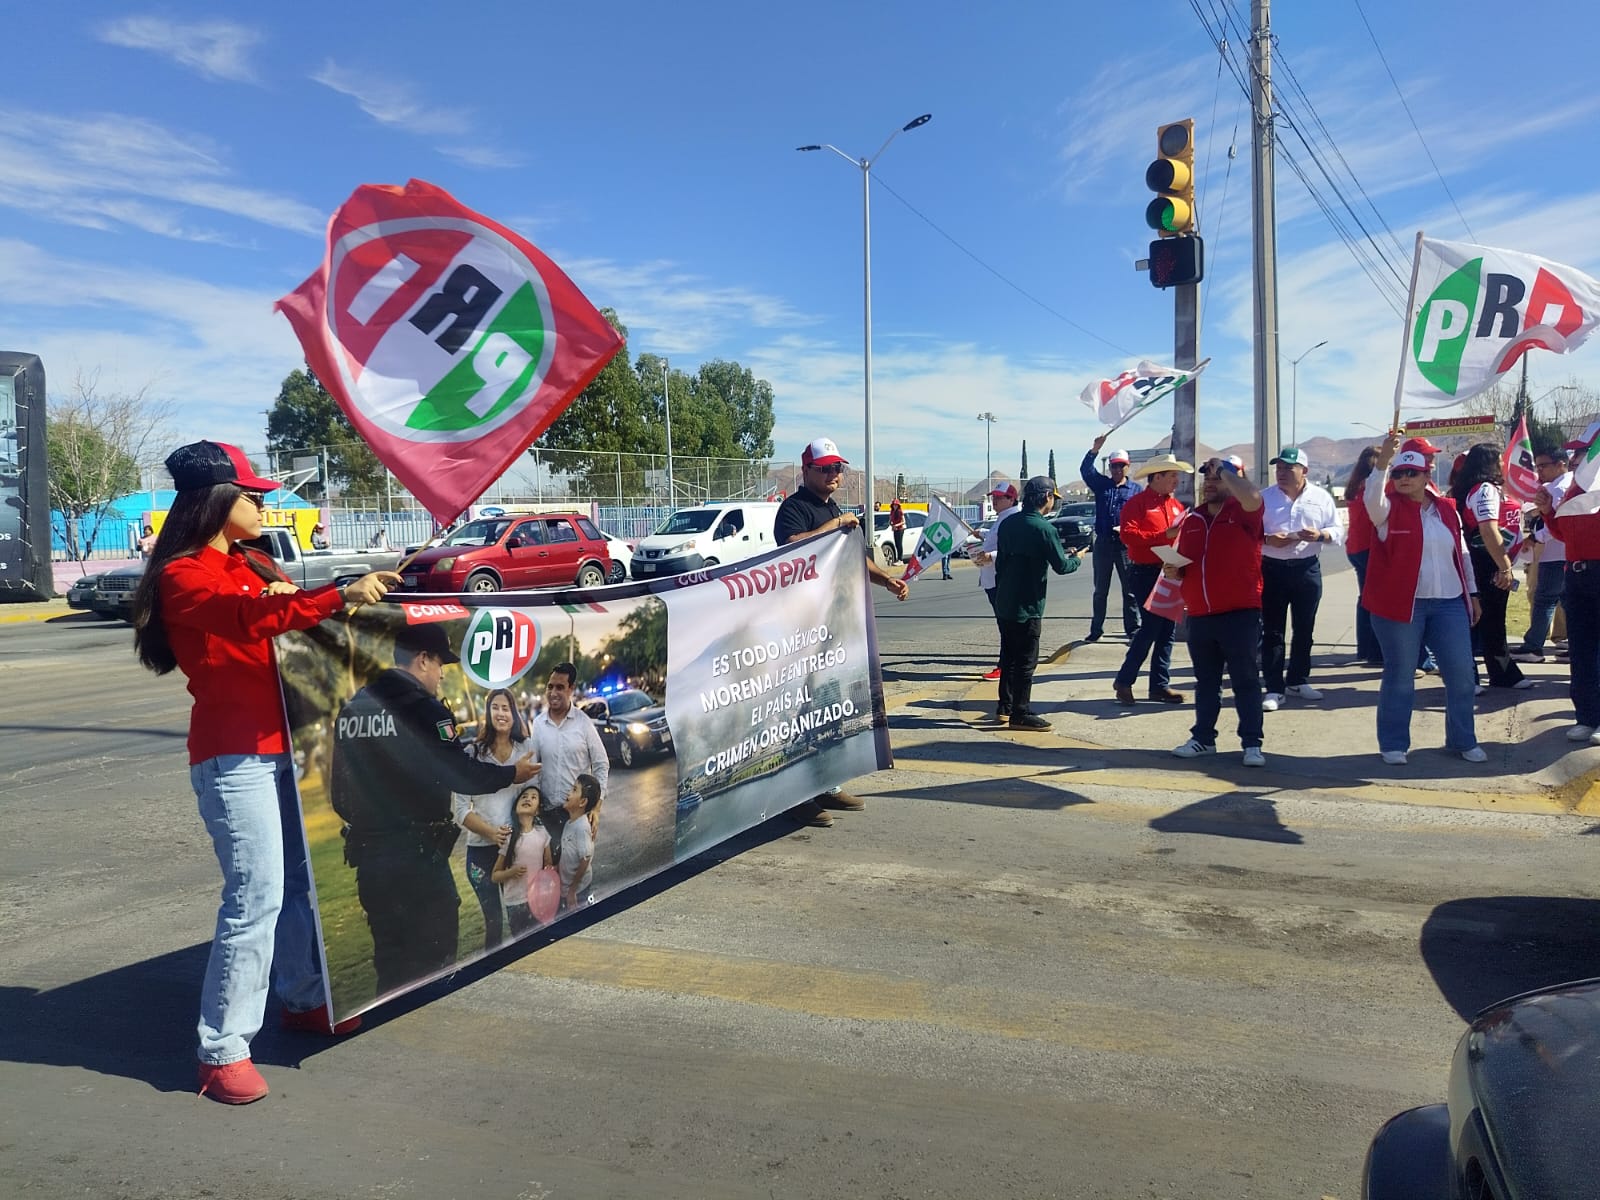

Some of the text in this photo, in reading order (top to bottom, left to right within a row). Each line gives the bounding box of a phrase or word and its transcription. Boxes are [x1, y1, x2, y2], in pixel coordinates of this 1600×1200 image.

[1420, 418, 1481, 428] PRECAUCIÓN
[678, 571, 710, 586] CON
[720, 554, 820, 600] morena
[408, 604, 465, 618] CON EL
[471, 616, 529, 665] PRI
[712, 624, 833, 677] ES TODO MÉXICO.
[700, 642, 847, 713] MORENA LE ENTREGÓ
[339, 709, 398, 740] POLICÍA
[751, 685, 812, 727] EL PAÍS AL
[704, 699, 859, 776] CRIMEN ORGANIZADO.
